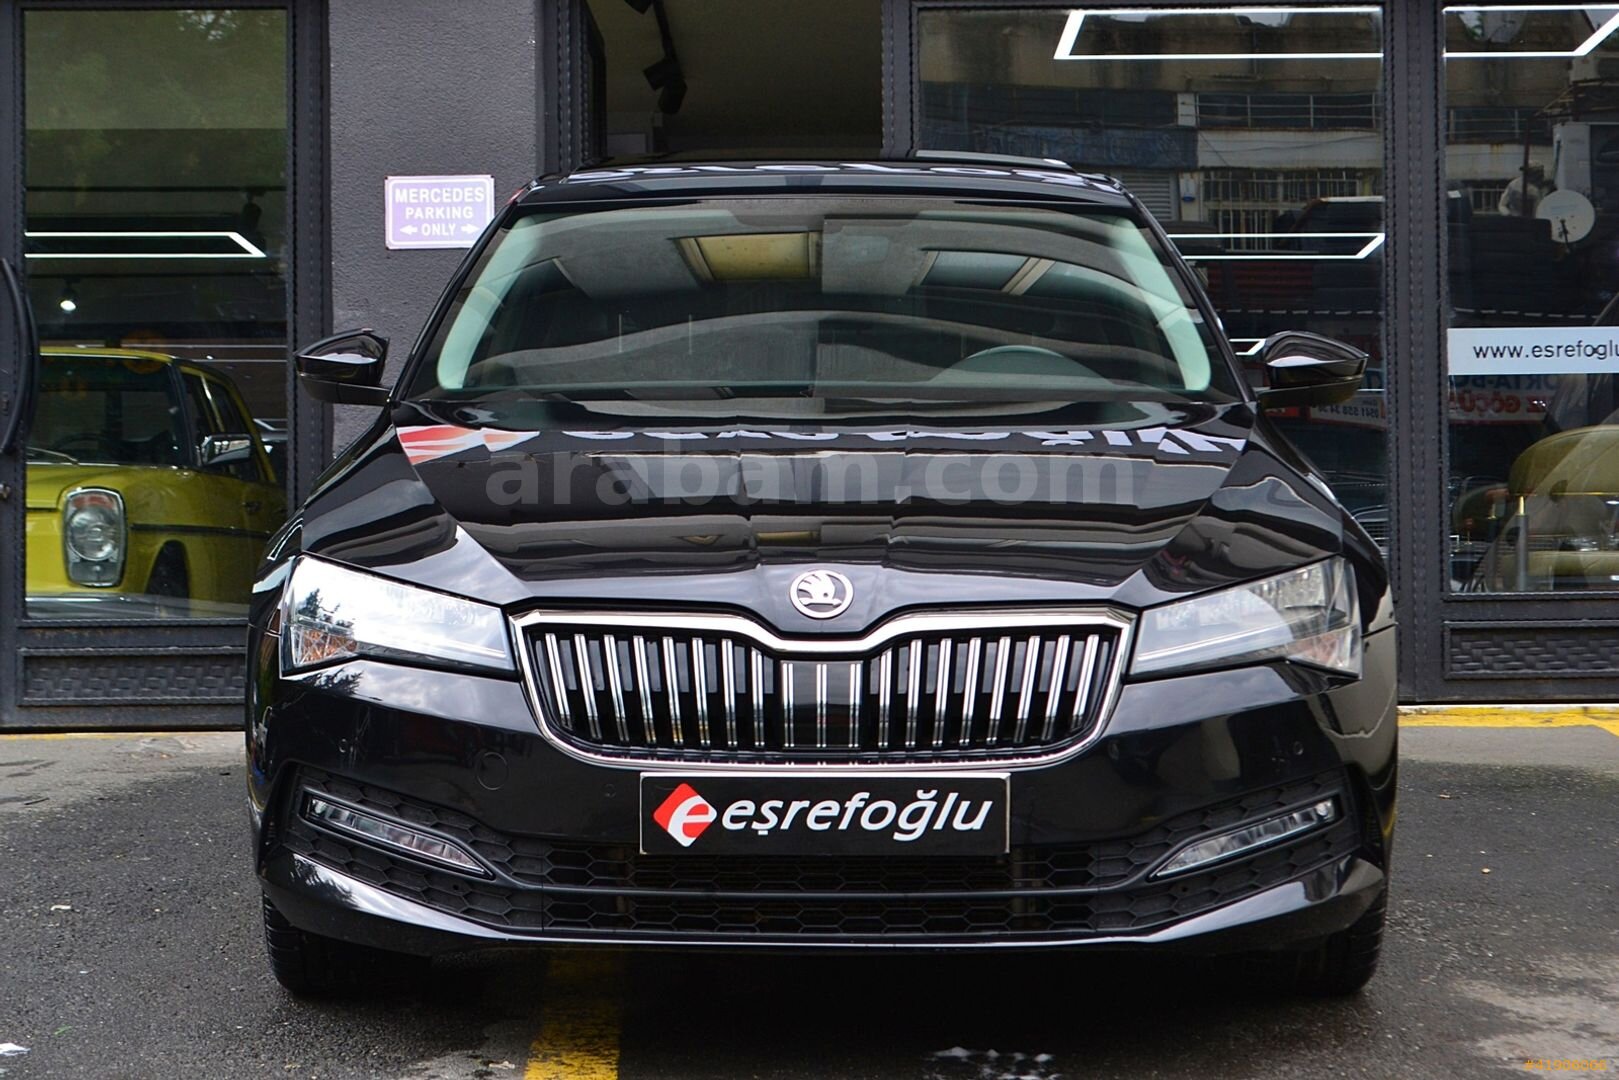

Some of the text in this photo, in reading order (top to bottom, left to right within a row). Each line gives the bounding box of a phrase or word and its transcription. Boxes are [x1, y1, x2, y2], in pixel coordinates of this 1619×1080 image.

[395, 187, 485, 203] MERCEDES
[405, 206, 474, 219] PARKING
[421, 223, 456, 236] ONLY
[722, 789, 993, 841] eşrefoğlu
